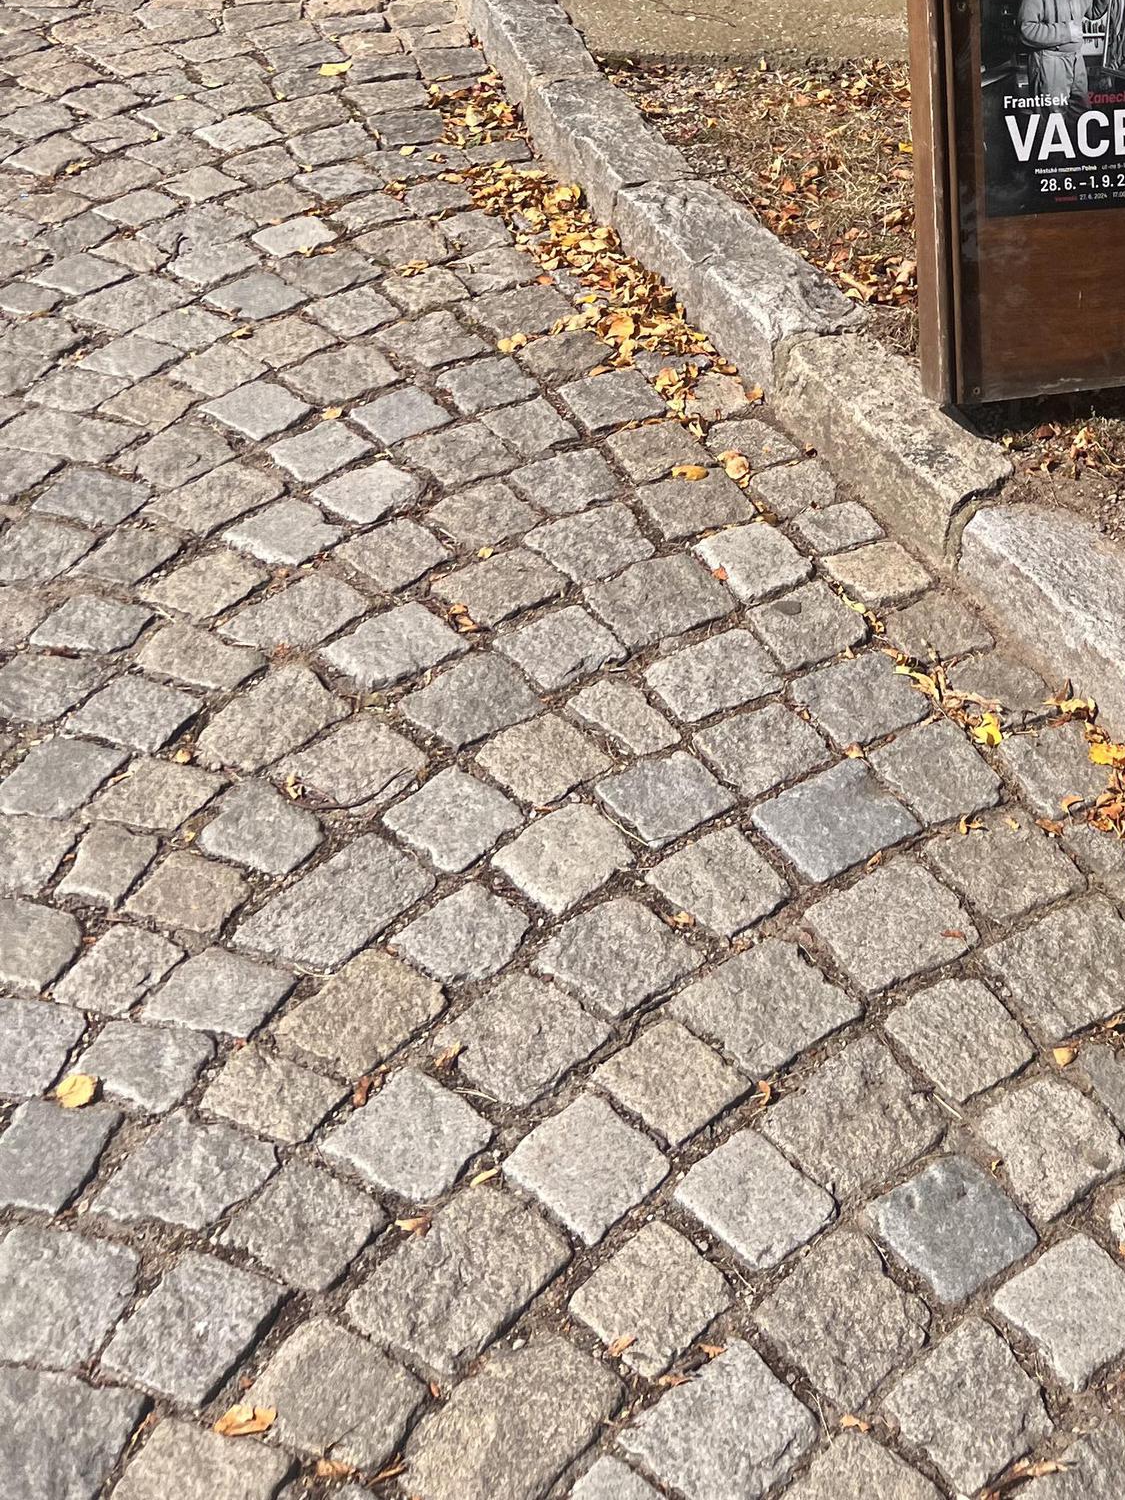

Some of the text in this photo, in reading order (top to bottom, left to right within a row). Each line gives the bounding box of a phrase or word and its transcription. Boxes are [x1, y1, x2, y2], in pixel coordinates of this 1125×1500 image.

[1004, 93, 1068, 109] František
[1040, 179, 1060, 192] 28.
[1064, 177, 1076, 190] 6.
[1089, 176, 1099, 188] 1.
[1102, 175, 1113, 187] 9.
